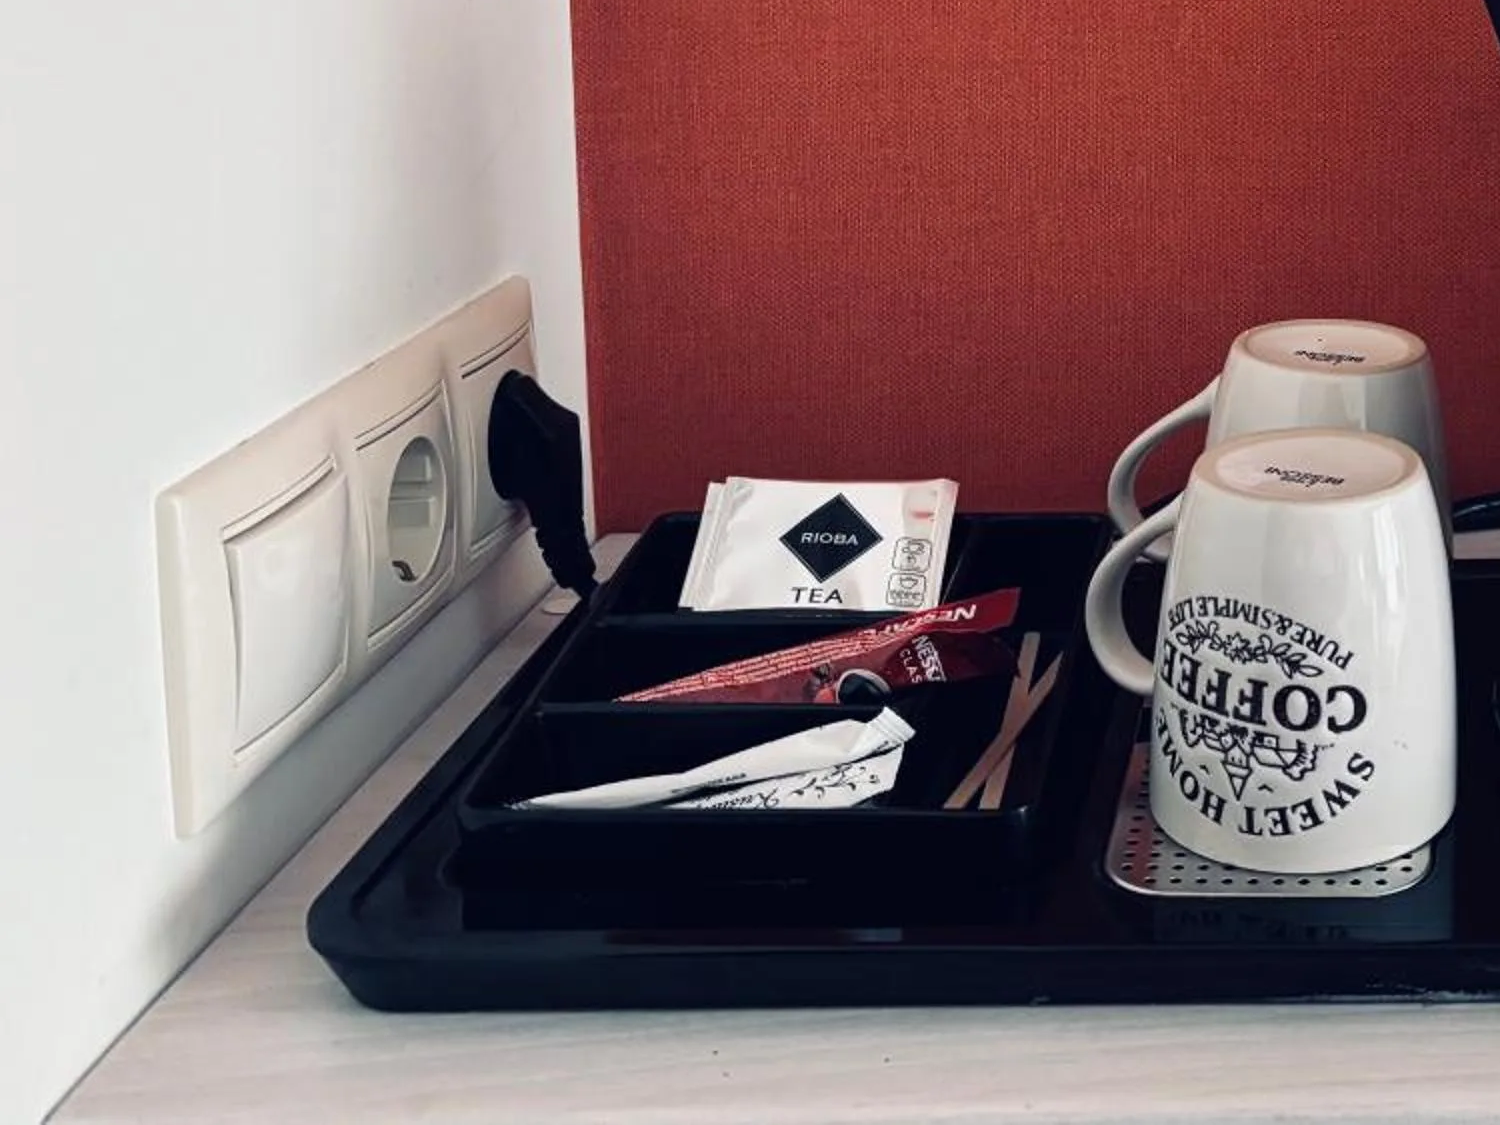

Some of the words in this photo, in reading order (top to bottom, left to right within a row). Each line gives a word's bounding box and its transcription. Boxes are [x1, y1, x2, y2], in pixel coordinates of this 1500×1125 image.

[801, 532, 859, 546] RIOBA
[791, 586, 843, 604] TEA
[1160, 638, 1367, 733] COFFEE
[1157, 706, 1228, 825] HOME
[1237, 752, 1375, 836] SWEET
